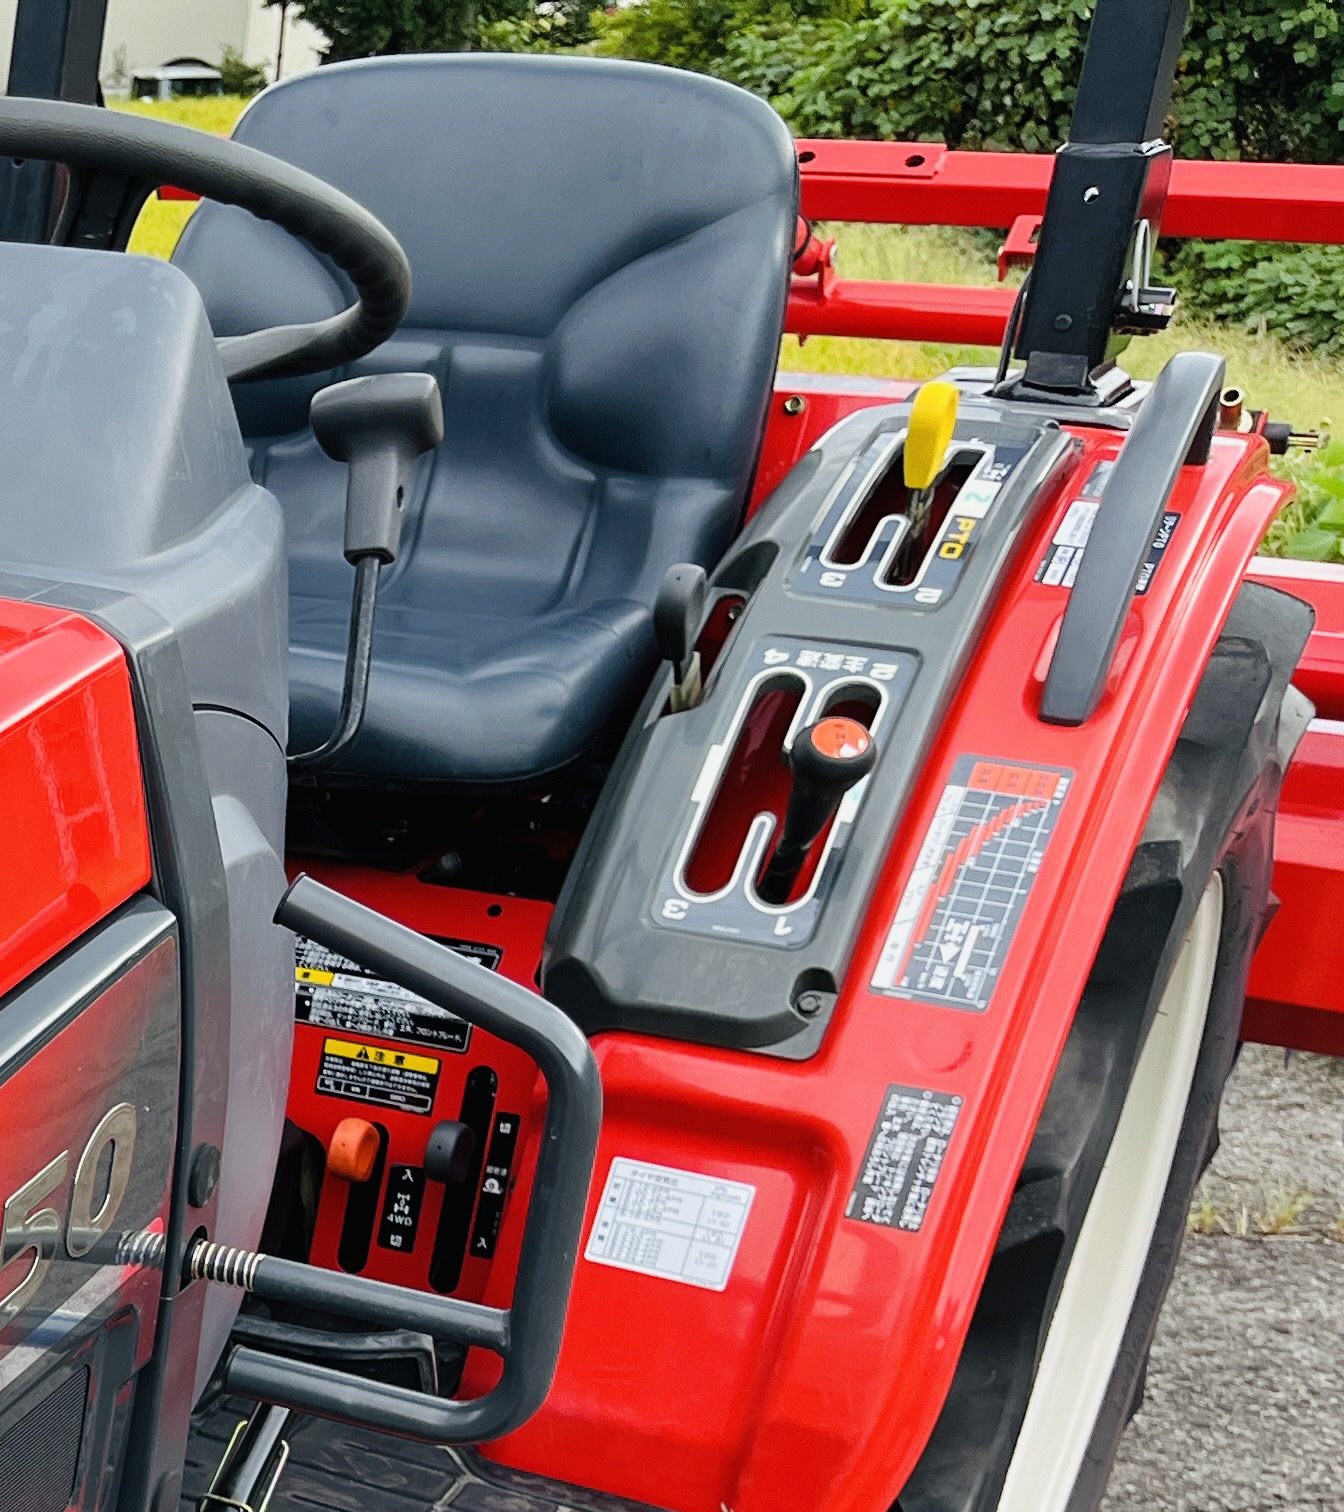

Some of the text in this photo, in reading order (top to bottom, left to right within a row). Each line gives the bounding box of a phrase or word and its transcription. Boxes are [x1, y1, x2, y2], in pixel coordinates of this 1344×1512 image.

[938, 517, 977, 559] PTO
[819, 571, 847, 587] 3
[914, 587, 943, 604] 2
[764, 649, 898, 681] 2 主変速 4
[662, 898, 689, 920] 3
[773, 916, 793, 936] 1
[386, 1213, 413, 1227] 4WD
